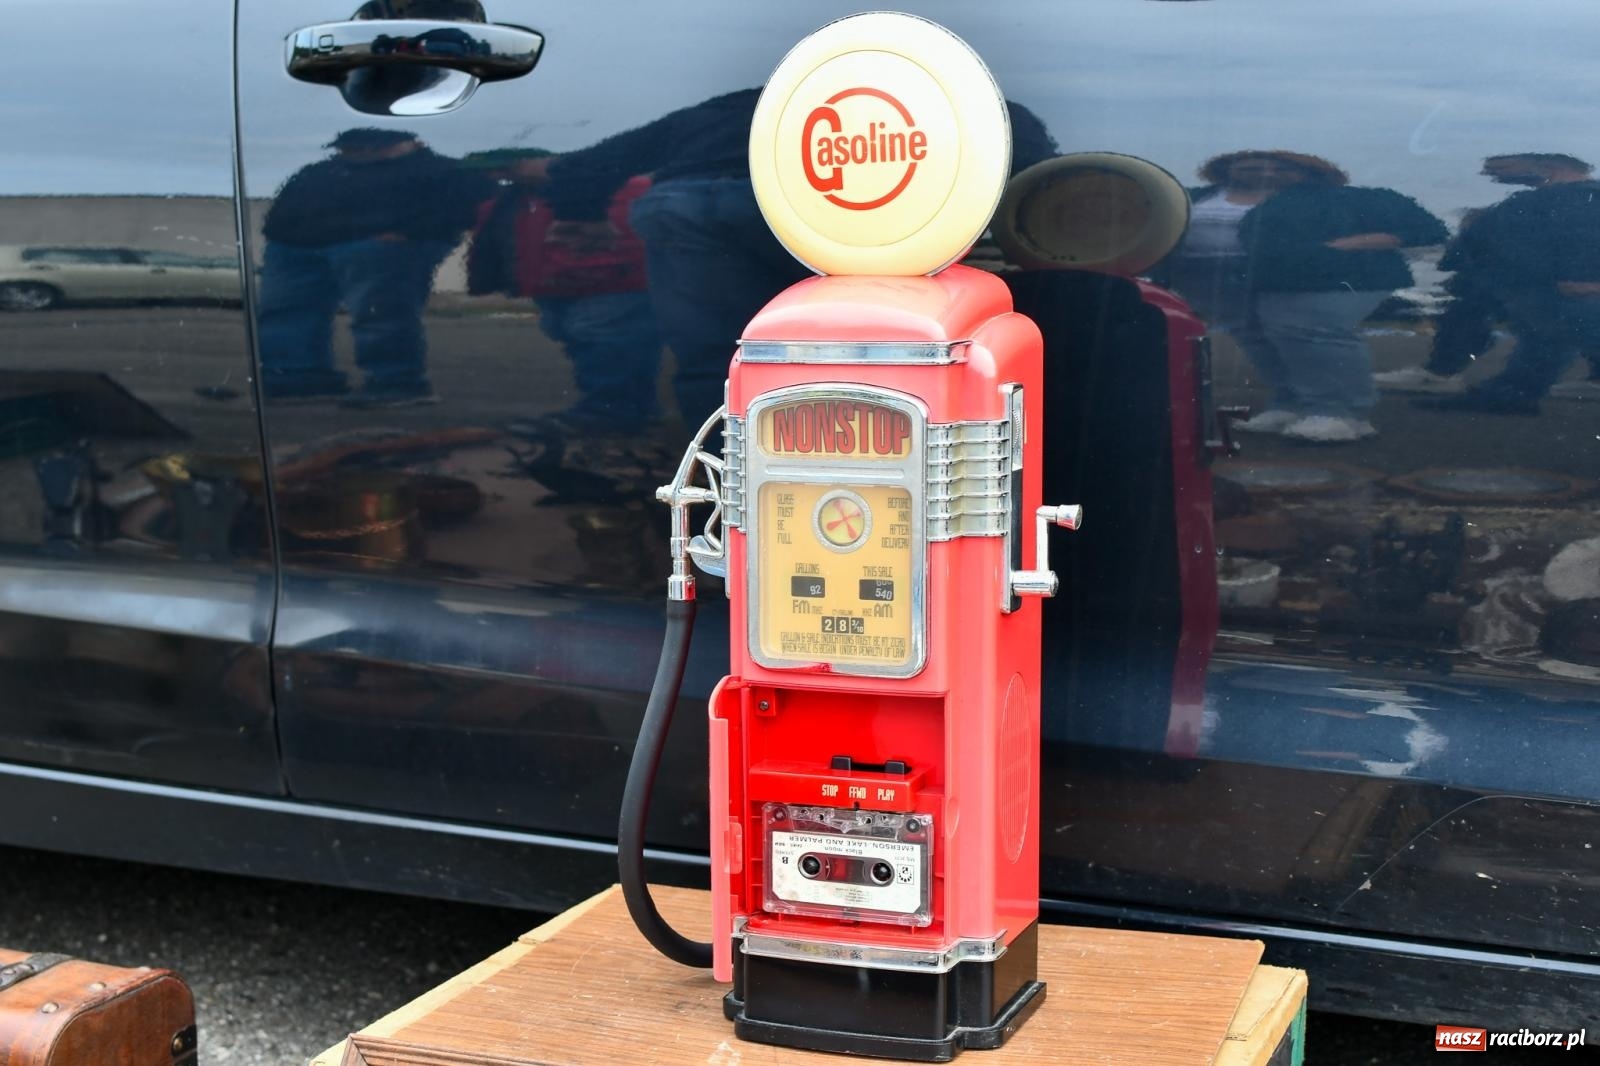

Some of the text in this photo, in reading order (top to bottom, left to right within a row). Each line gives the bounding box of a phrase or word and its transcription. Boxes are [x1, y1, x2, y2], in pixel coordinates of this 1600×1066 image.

[801, 106, 928, 192] Gasoline
[773, 401, 911, 455] NONSTOP
[777, 506, 793, 517] MUST
[777, 519, 785, 531] BE
[889, 524, 909, 536] AFTER
[777, 532, 793, 545] FULL
[881, 537, 909, 549] DELIVERY
[795, 562, 819, 575] GALLONS
[863, 565, 893, 578] THIS SALE
[809, 584, 822, 596] 92
[875, 587, 892, 600] 540
[792, 599, 811, 614] FM
[873, 602, 893, 618] AM
[806, 632, 820, 644] SALE
[873, 636, 881, 647] BE
[798, 642, 811, 654] SALE
[812, 643, 819, 654] IS
[839, 644, 857, 656] UNDER
[892, 647, 905, 659] LAW
[821, 784, 839, 797] STOP
[849, 786, 866, 800] FFWD
[877, 788, 895, 801] PLAY
[788, 835, 823, 844] PALMER
[826, 838, 844, 846] AND
[846, 839, 867, 848] LAKE
[781, 856, 789, 865] B
